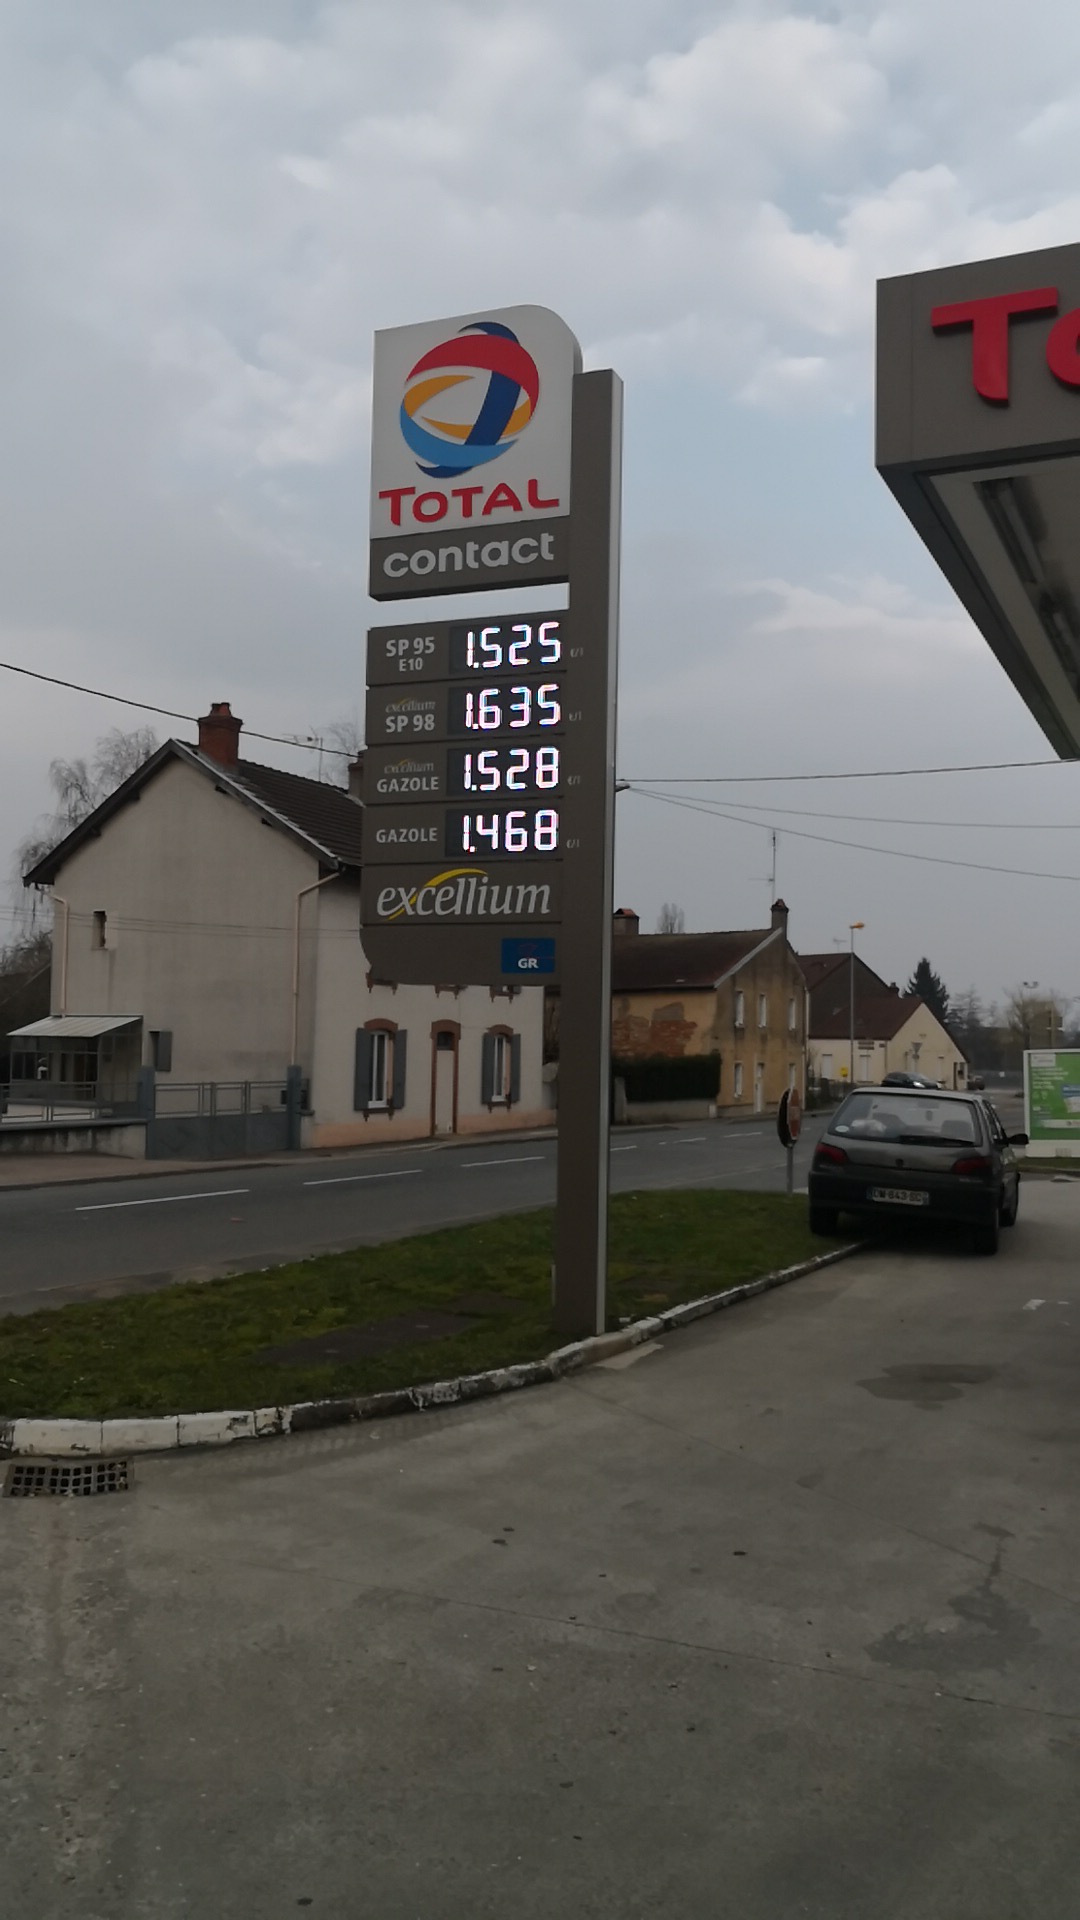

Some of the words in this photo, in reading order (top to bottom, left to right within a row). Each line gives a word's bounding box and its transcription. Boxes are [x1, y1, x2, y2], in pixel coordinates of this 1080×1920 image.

[930, 286, 1080, 401] T
[378, 478, 560, 526] TOTAL
[383, 532, 555, 578] contact
[385, 638, 410, 658] SP
[413, 636, 436, 656] 95
[398, 657, 424, 672] E10
[466, 621, 562, 669] 1.525
[385, 715, 409, 733] SP
[413, 713, 436, 731] 98
[465, 683, 562, 730] 1.635
[376, 776, 440, 794] GAZOLE
[464, 746, 560, 791] 1.528
[375, 827, 438, 844] GAZOLE
[463, 809, 559, 853] 1.468
[376, 875, 551, 917] excellium
[517, 957, 540, 969] GR
